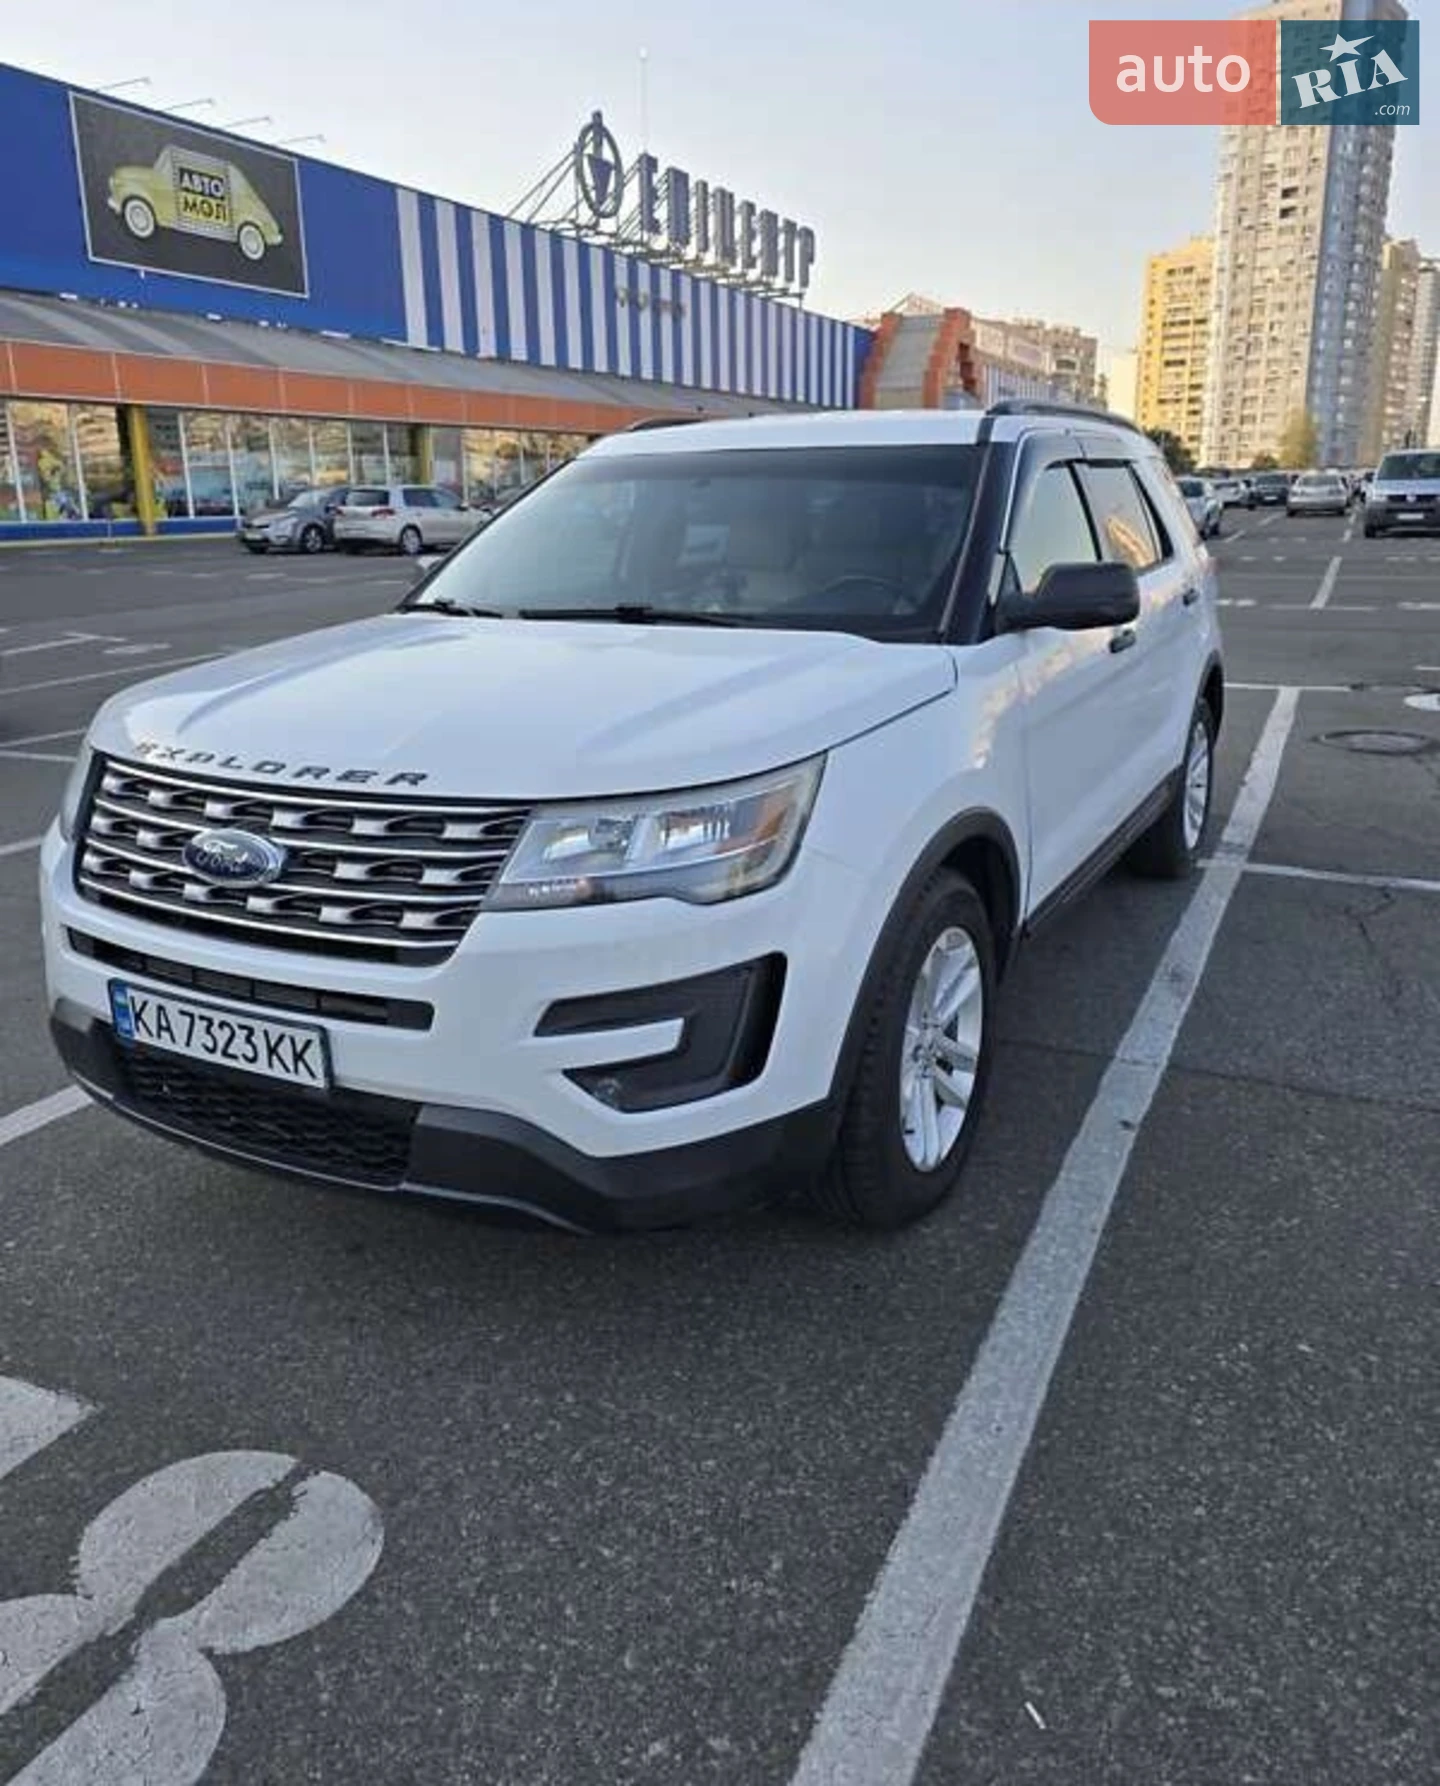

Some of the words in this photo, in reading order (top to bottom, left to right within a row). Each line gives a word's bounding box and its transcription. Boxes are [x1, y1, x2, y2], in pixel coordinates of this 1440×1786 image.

[181, 171, 225, 198] АВТО
[183, 196, 227, 222] МОЛ
[133, 742, 428, 786] EXPLORER
